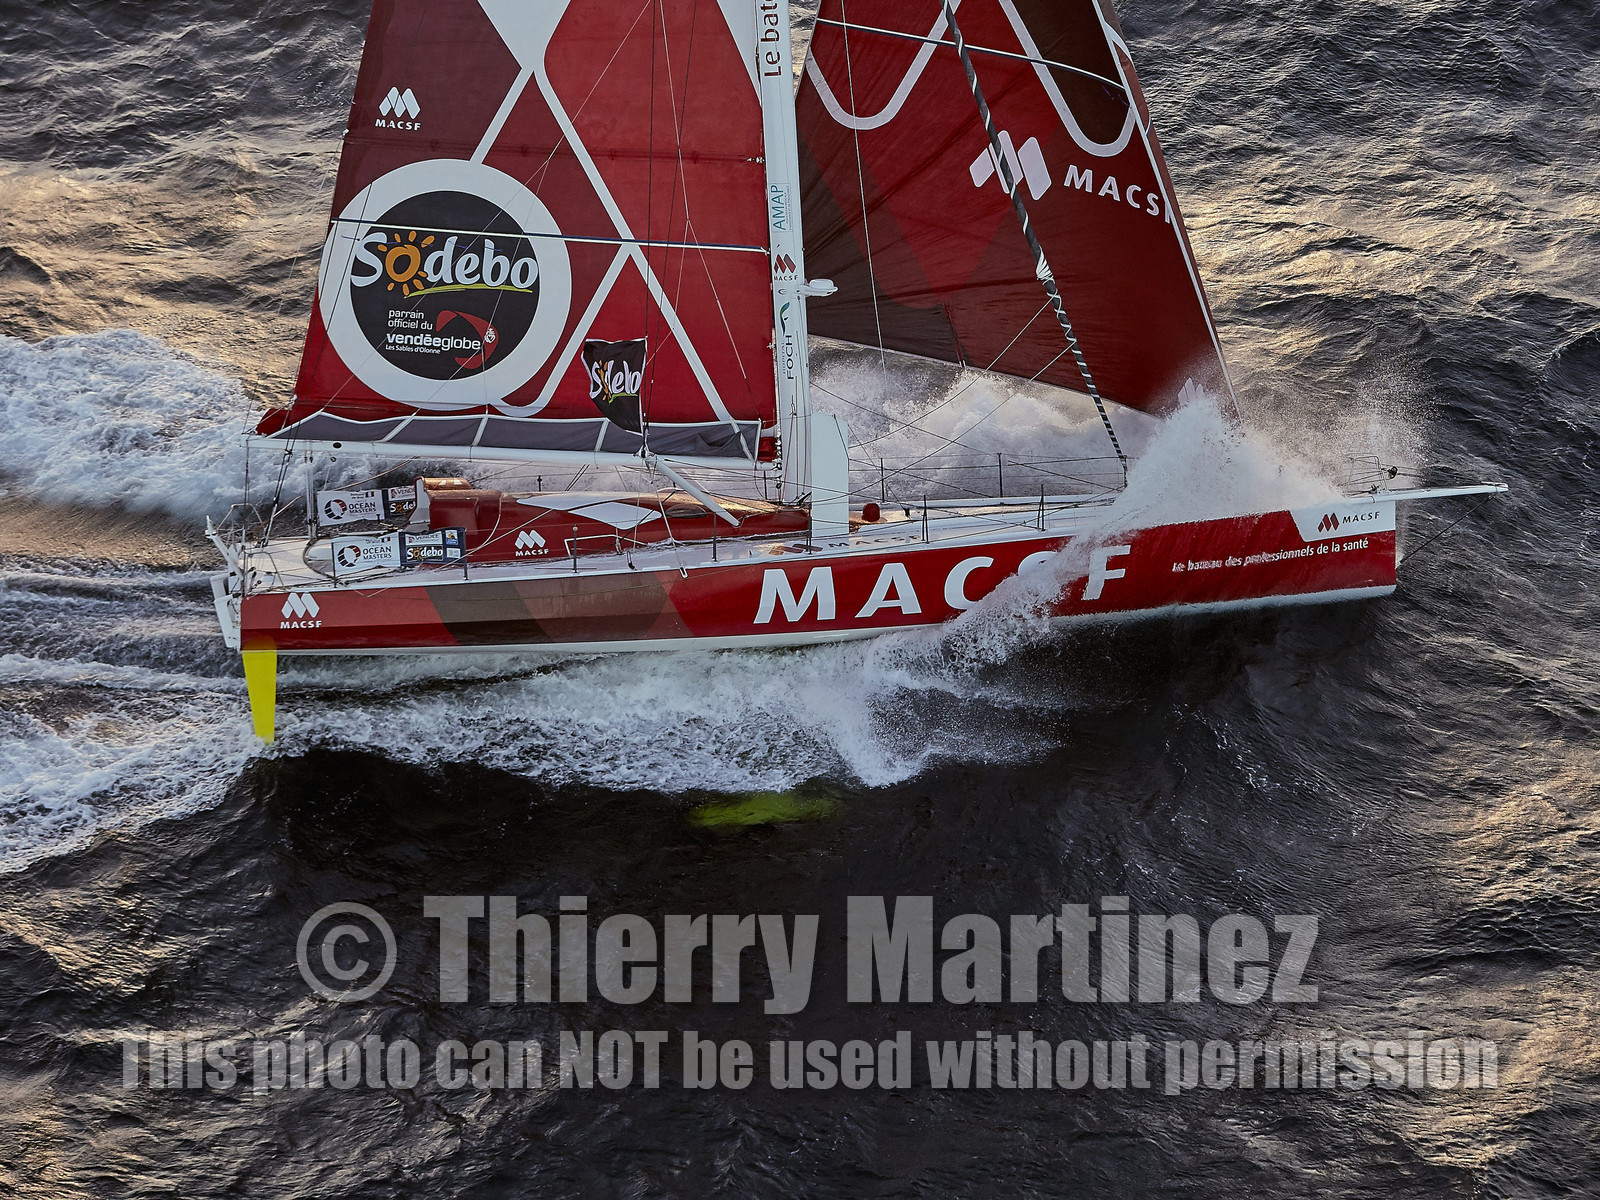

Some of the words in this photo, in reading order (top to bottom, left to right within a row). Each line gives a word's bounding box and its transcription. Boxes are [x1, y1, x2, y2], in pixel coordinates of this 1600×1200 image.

[764, 50, 783, 78] Le
[375, 118, 421, 131] MACSF
[771, 184, 786, 230] AMAP
[350, 231, 540, 296] Sodebo
[388, 309, 425, 319] parrain
[387, 318, 418, 329] officiel
[420, 321, 433, 330] du
[785, 335, 794, 379] FOCH
[348, 502, 376, 510] OCEAN
[1342, 511, 1380, 523] MACSF
[362, 546, 392, 555] OCEAN
[1317, 544, 1329, 555] de
[1331, 541, 1341, 552] la
[1342, 536, 1369, 550] santé
[407, 547, 443, 560] Sodebo
[515, 548, 549, 557] MACSF
[280, 620, 322, 629] MACSF
